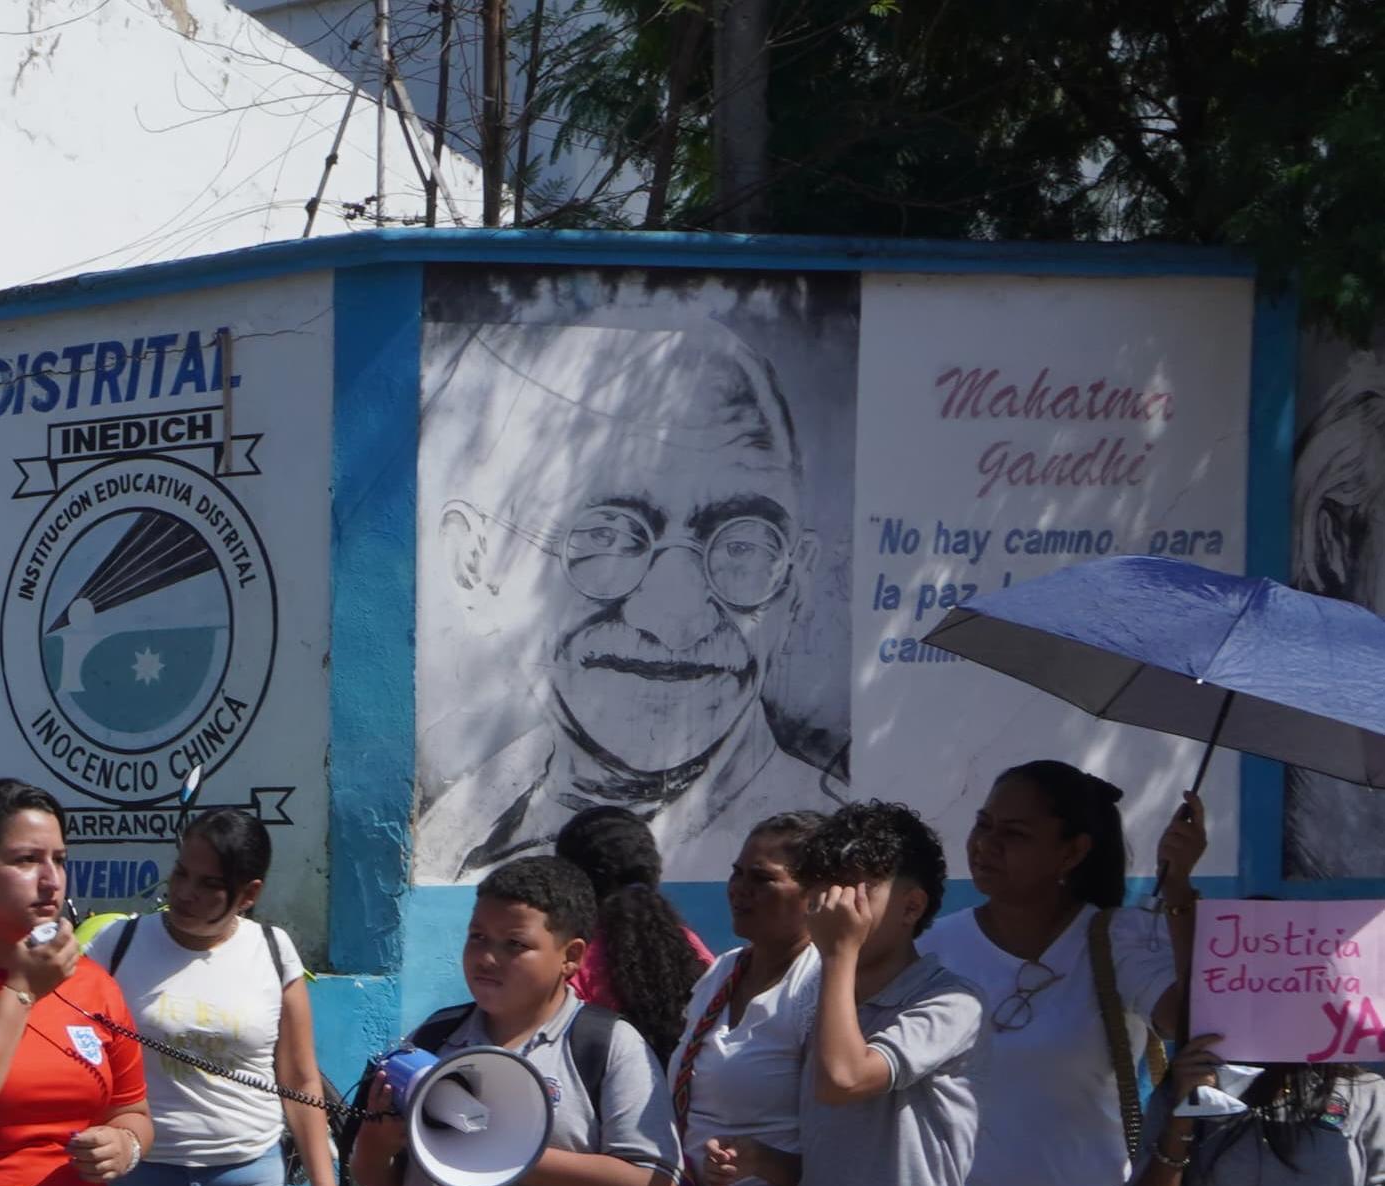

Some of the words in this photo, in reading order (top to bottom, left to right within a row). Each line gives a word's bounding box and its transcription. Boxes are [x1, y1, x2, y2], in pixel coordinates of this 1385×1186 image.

[934, 365, 1174, 421] Mahatma
[61, 413, 212, 454] INEDICH
[977, 437, 1154, 497] Gandhi
[18, 488, 93, 601] INSTITUCIÓN
[95, 472, 195, 507] EDUCATIVA
[199, 496, 257, 589] DISTRITAL
[933, 521, 993, 563] hay
[1149, 526, 1224, 556] para
[873, 573, 901, 611] la
[31, 708, 159, 793] INOCENCIO
[169, 688, 248, 780] CHINCÁ
[1209, 915, 1360, 958] Justicia
